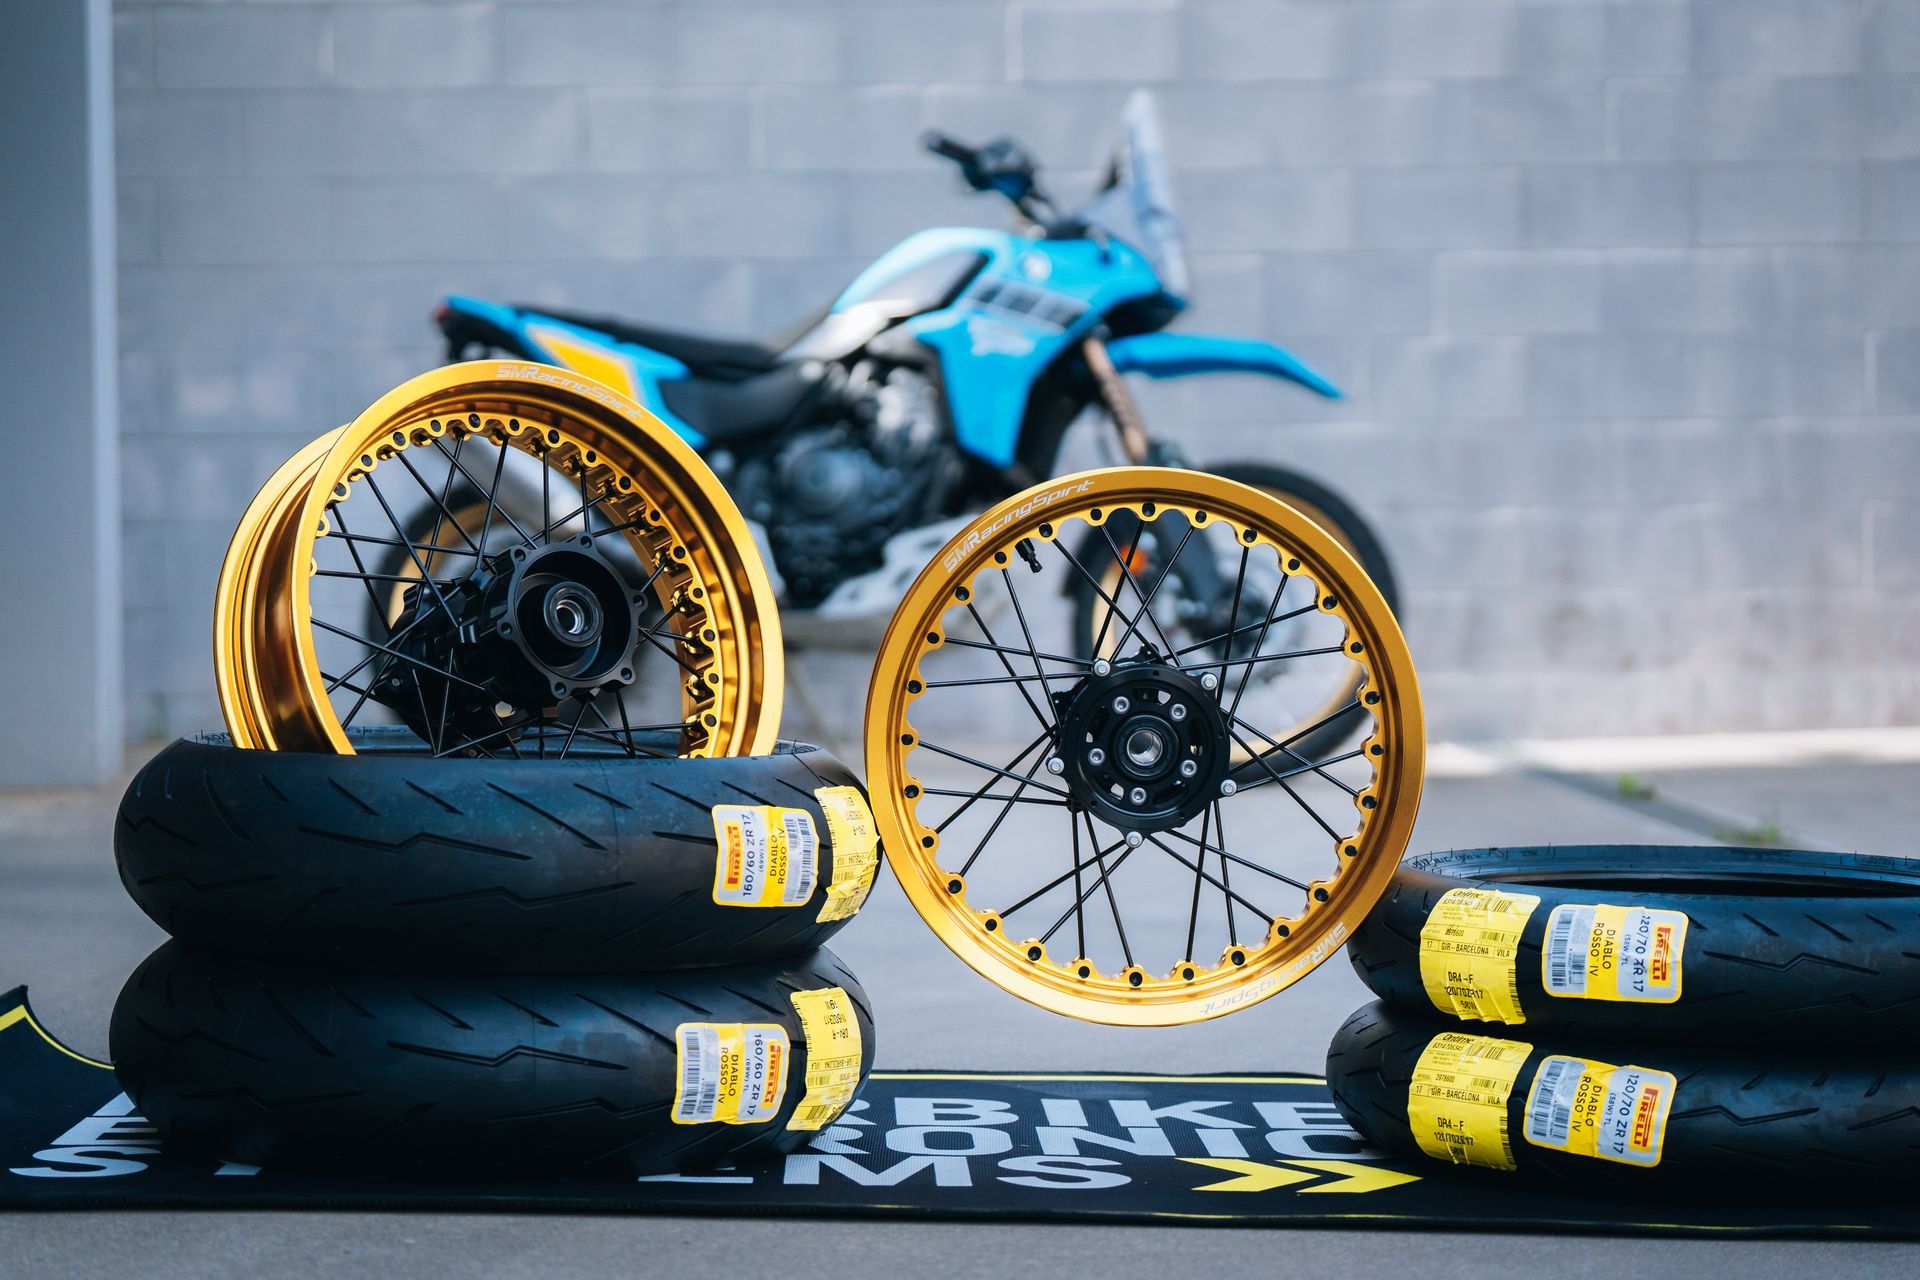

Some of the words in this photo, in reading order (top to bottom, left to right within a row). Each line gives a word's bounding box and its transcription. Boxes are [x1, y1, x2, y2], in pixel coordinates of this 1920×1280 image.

[943, 479, 1095, 574] SMRacingSpirit
[741, 813, 751, 827] 17
[746, 829, 755, 846] ZR
[777, 827, 786, 839] IV
[727, 825, 740, 885] PIRELLI
[769, 834, 778, 877] DIABLO
[777, 846, 787, 885] ROSSO
[742, 850, 755, 897] 160/60
[1589, 922, 1605, 958] ROSSO
[1604, 929, 1616, 970] DIABLO
[1633, 914, 1651, 955] 120/70
[1496, 949, 1510, 958] VILA
[1588, 964, 1599, 977] IV
[1633, 957, 1645, 976] ZR
[1652, 926, 1671, 981] PIRELLI
[1632, 978, 1645, 994] 17
[719, 1046, 730, 1086] ROSSO
[753, 1033, 764, 1080] 160/60
[764, 1044, 781, 1104] PIRELLI
[729, 1054, 739, 1097] DIABLO
[751, 1083, 762, 1101] ZR
[717, 1093, 725, 1104] IV
[746, 1104, 757, 1116] 17
[1416, 1085, 1422, 1093] 17
[1487, 1095, 1501, 1105] VILA
[1573, 1076, 1593, 1113] ROSSO
[1585, 1085, 1602, 1127] DIABLO
[1618, 1073, 1640, 1117] 120/70
[1571, 1120, 1582, 1133] IV
[1602, 1117, 1611, 1126] TL
[1613, 1119, 1627, 1141] ZR
[1633, 1087, 1659, 1147] PIRELLI
[1611, 1141, 1624, 1155] 17
